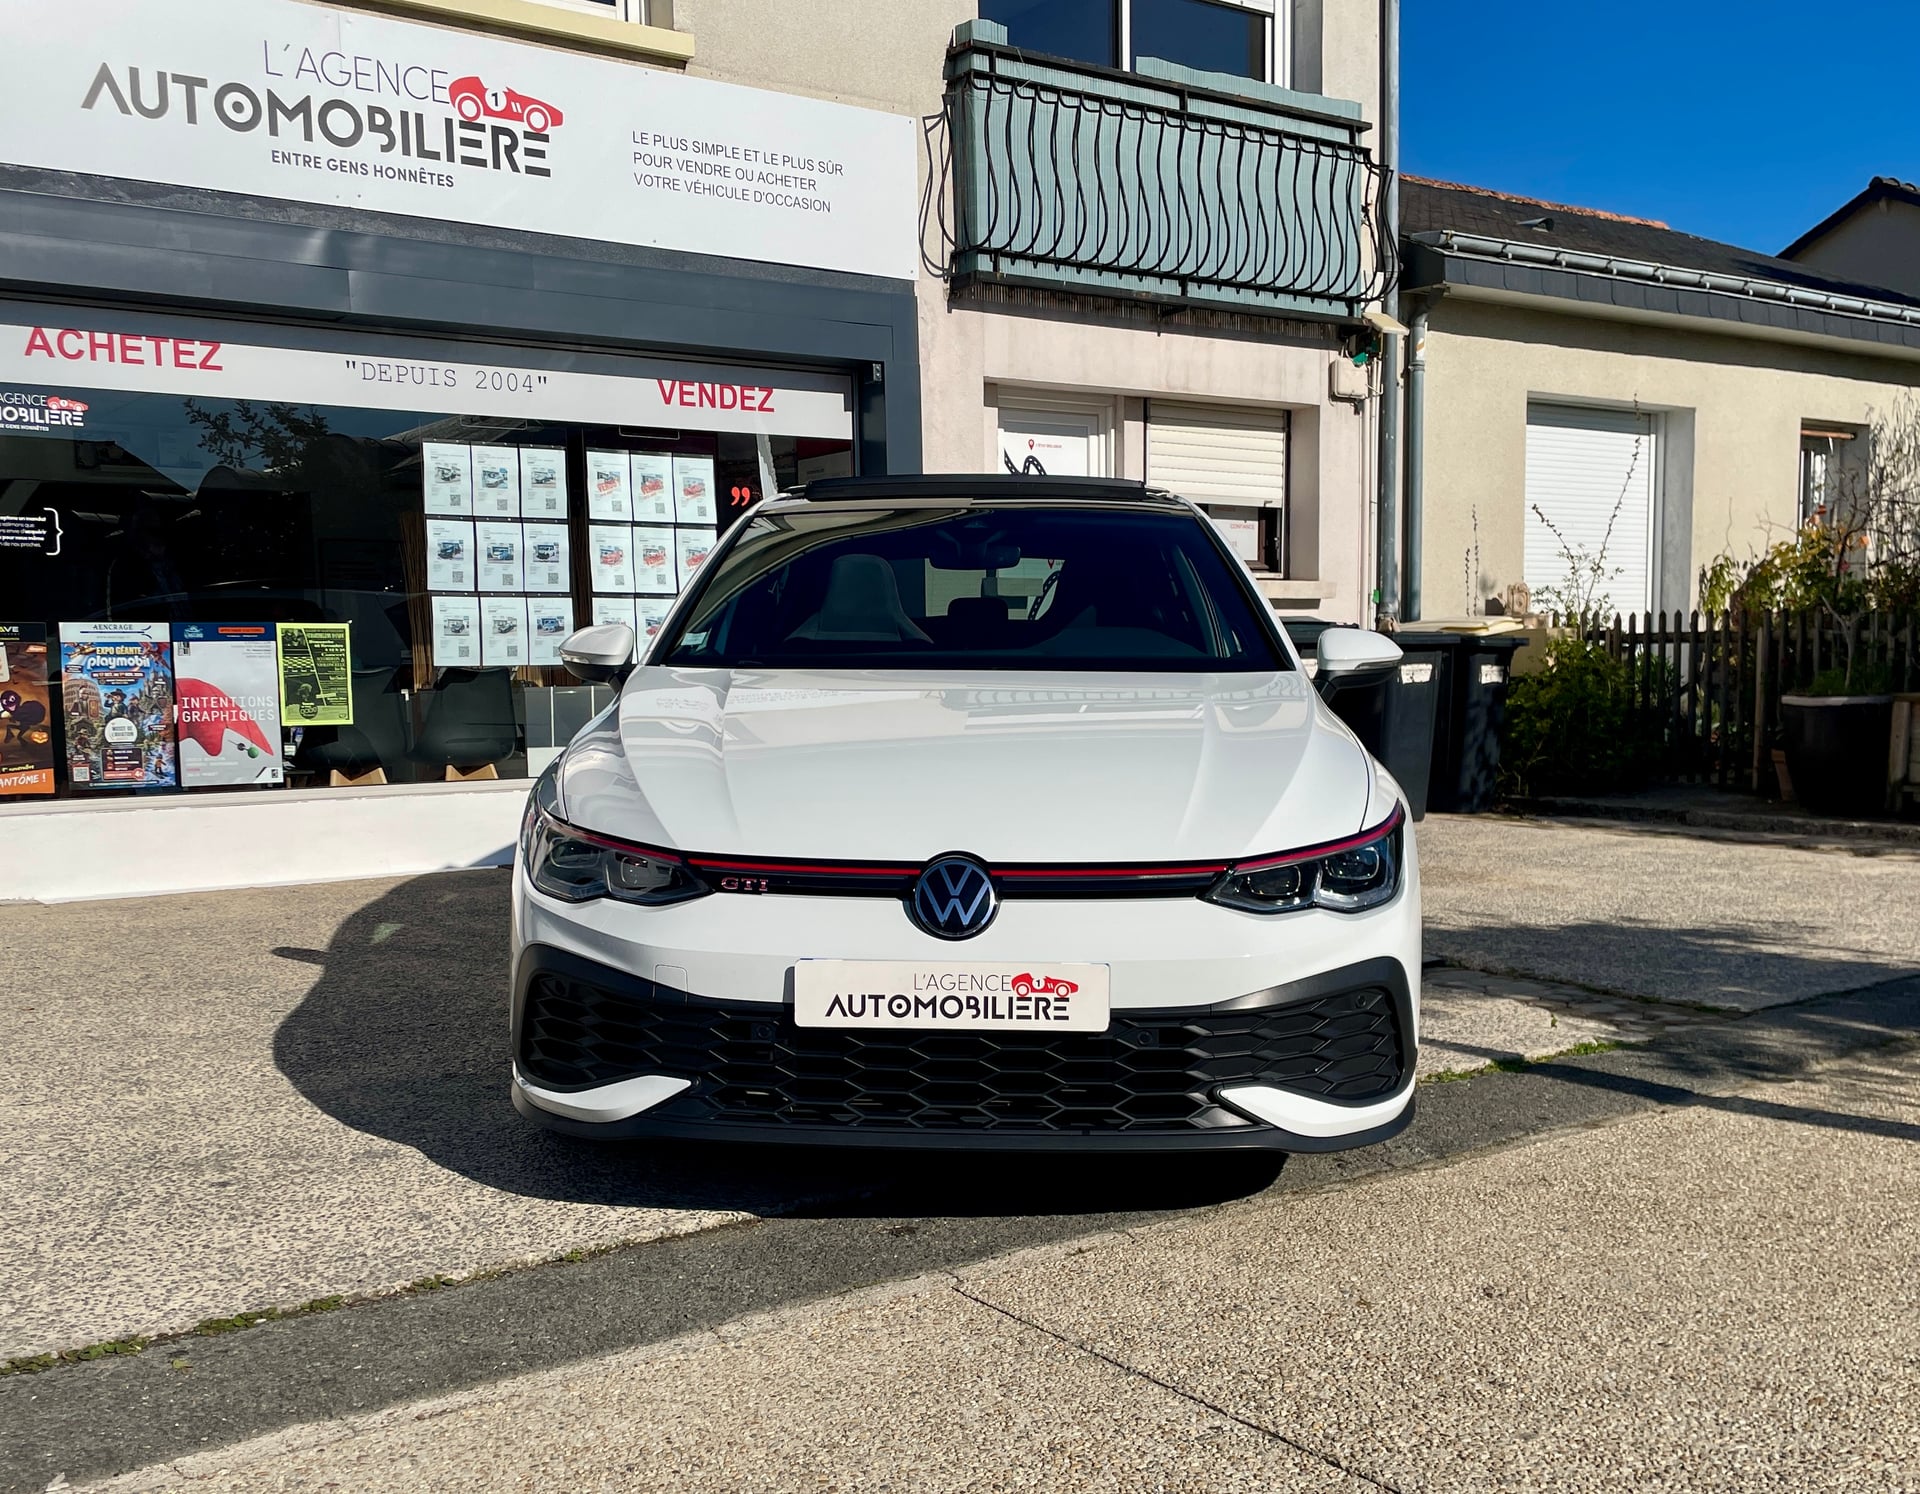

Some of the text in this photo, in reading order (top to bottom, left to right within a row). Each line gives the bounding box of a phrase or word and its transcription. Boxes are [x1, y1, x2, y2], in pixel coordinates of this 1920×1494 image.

[263, 39, 450, 105] L'AGENCE
[631, 130, 844, 177] LE PLUS SIMPLE ET LE PLUS SÛR
[271, 149, 455, 188] ENTRE GENS HONNÊTES
[633, 151, 818, 192] POUR VENDRE OU ACHETER
[633, 172, 832, 214] VOTRE VÉHICULE D'OCCASION
[24, 325, 224, 372] ACHETEZ
[656, 378, 775, 414] VENDEZ
[0, 405, 85, 427] OBILIERE
[87, 655, 150, 670] playmobil
[96, 645, 143, 655] EXPO GÉANTE
[182, 696, 274, 709] INTENTIONS
[182, 709, 275, 722] GRAPHIQUES
[720, 876, 770, 892] GTI
[914, 973, 1012, 993] L'AGENCE
[825, 994, 1070, 1021] AUTOMOBILIERE
